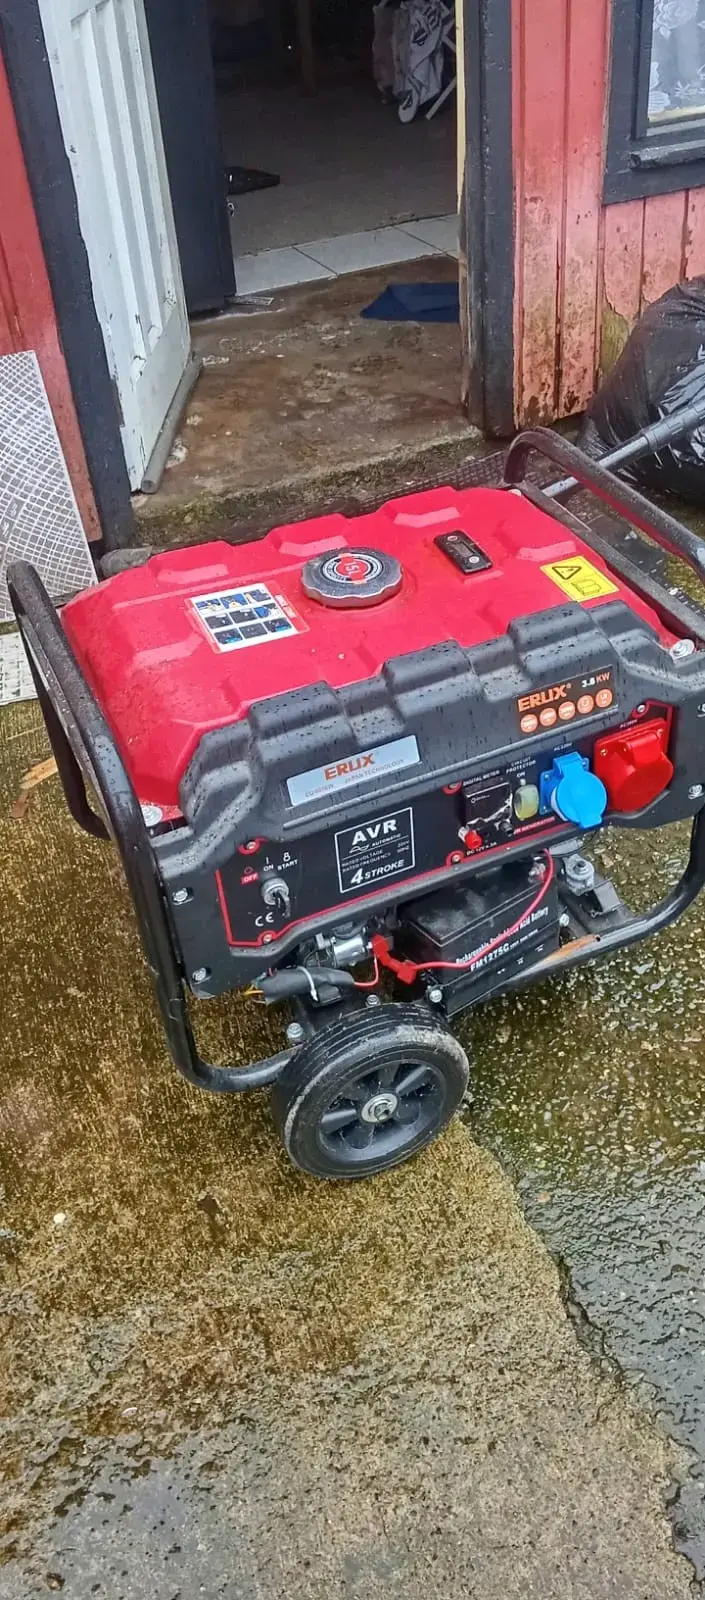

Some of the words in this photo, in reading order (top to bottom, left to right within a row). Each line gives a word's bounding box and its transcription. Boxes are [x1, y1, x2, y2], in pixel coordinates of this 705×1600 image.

[364, 759, 405, 777] TECHNOLOGY
[506, 760, 536, 774] PROTECTOR
[511, 757, 531, 767] CIRCUIT
[463, 776, 482, 786] DIGITAL
[483, 770, 500, 780] METER
[352, 820, 397, 845] AVR
[372, 833, 401, 847] AUTOMATIC
[277, 859, 298, 870] START
[342, 858, 359, 867] RATED
[360, 850, 383, 861] VOLTAGE
[342, 864, 359, 872] RATED
[360, 852, 391, 865] FREQUENCY
[263, 864, 274, 872] ON
[351, 868, 363, 884] 4
[364, 859, 404, 880] STROKE
